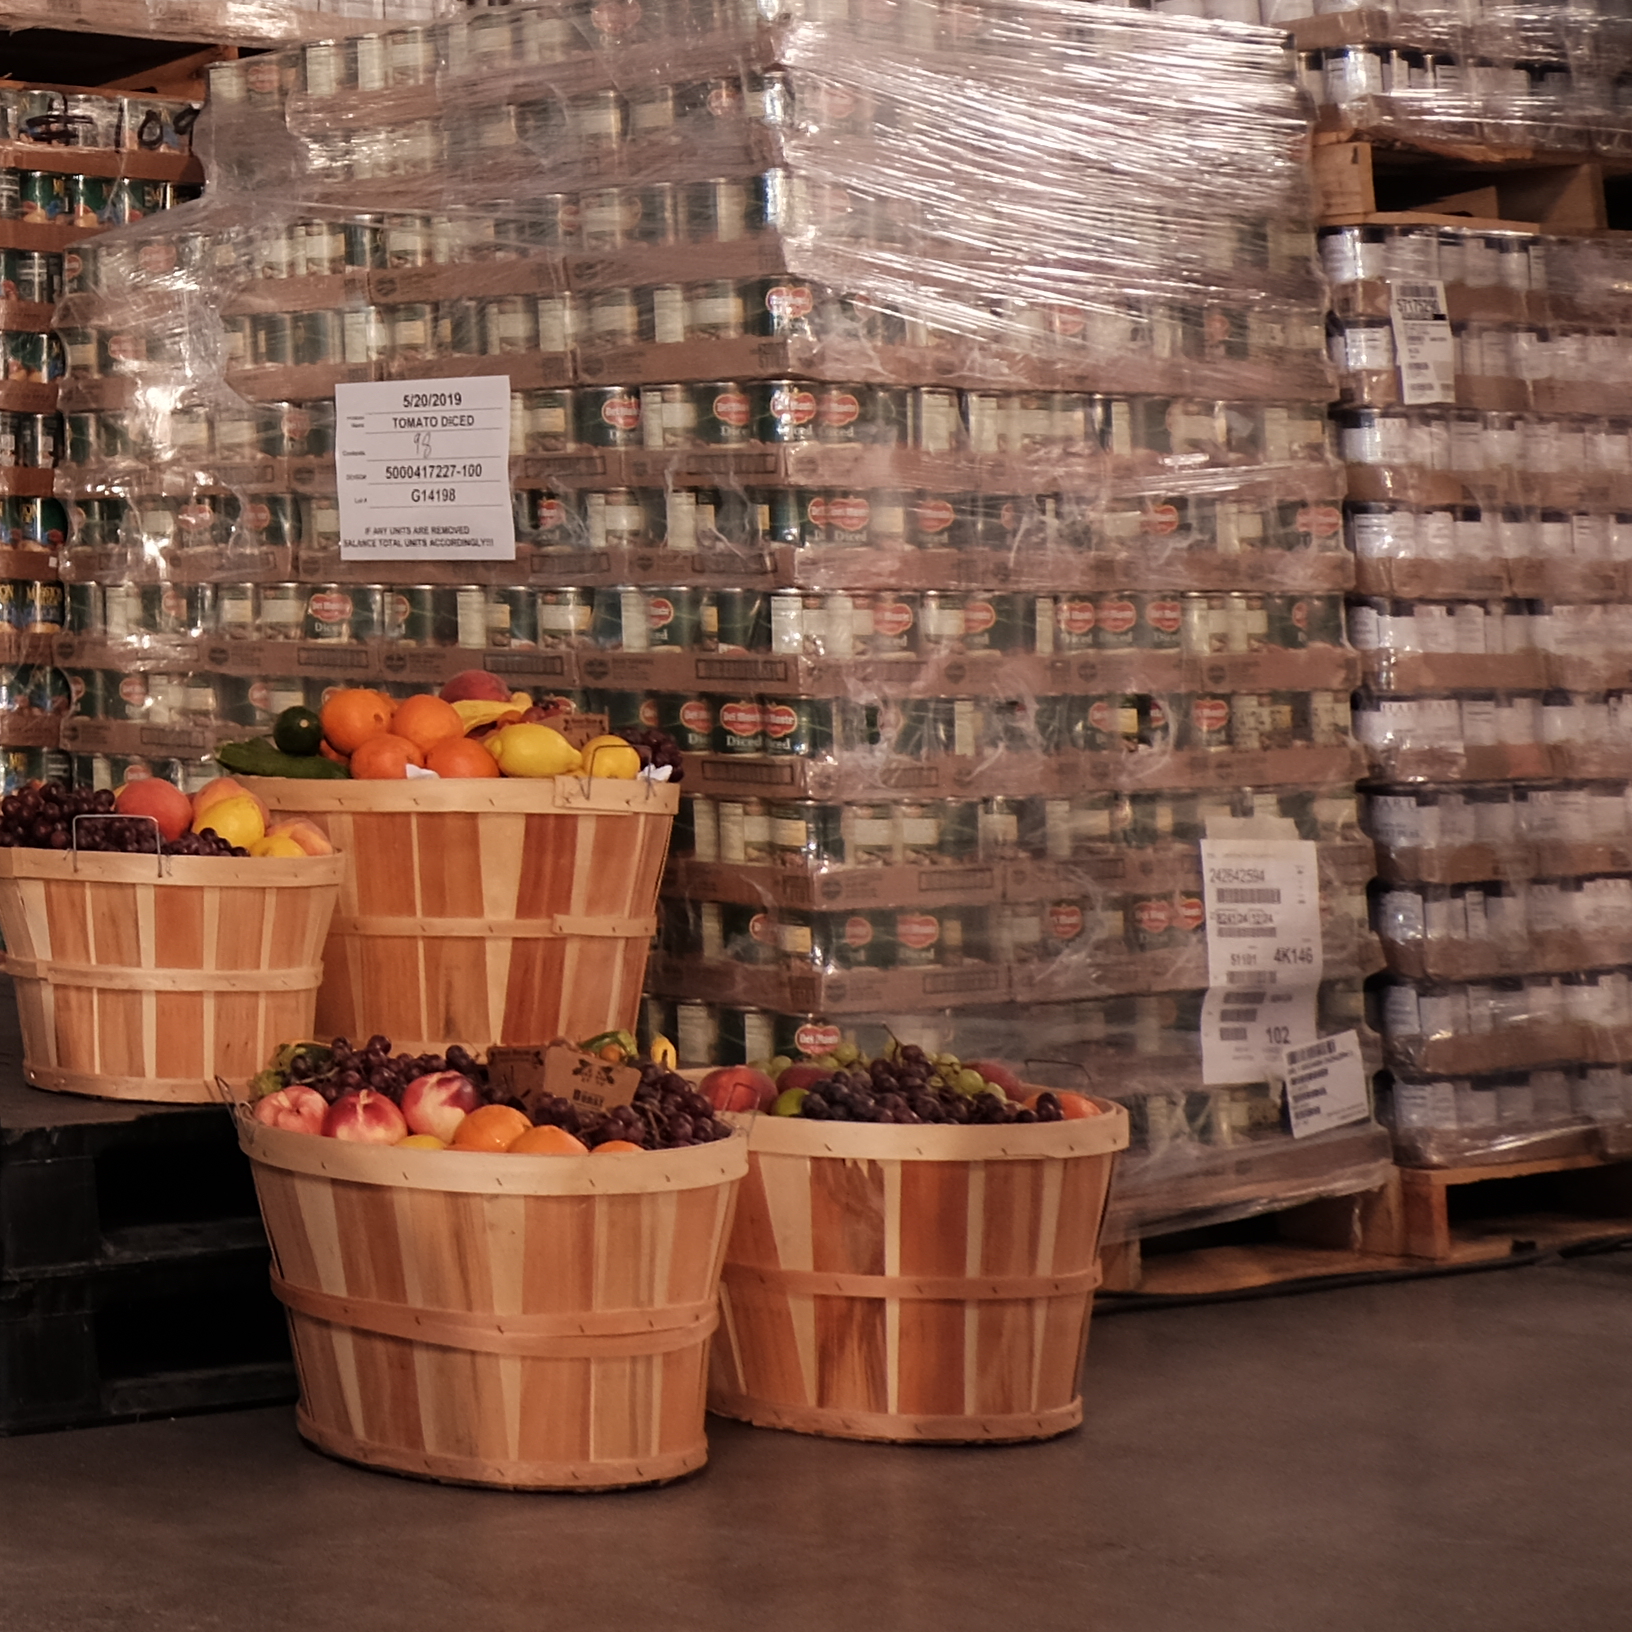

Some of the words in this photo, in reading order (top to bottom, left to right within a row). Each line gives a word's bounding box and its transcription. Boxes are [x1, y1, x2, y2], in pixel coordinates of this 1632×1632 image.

[403, 393, 462, 407] 5/20/2019
[392, 417, 438, 429] TOMATO
[441, 415, 474, 427] DICED
[386, 464, 482, 479] 5000417227-100
[411, 489, 456, 502] G14198
[431, 526, 469, 534] REMOVED
[343, 539, 376, 547] BALANCE
[378, 539, 403, 547] TOTAL
[405, 539, 427, 547] UNITS
[726, 734, 762, 747] Diced
[1266, 1027, 1290, 1044] 102
